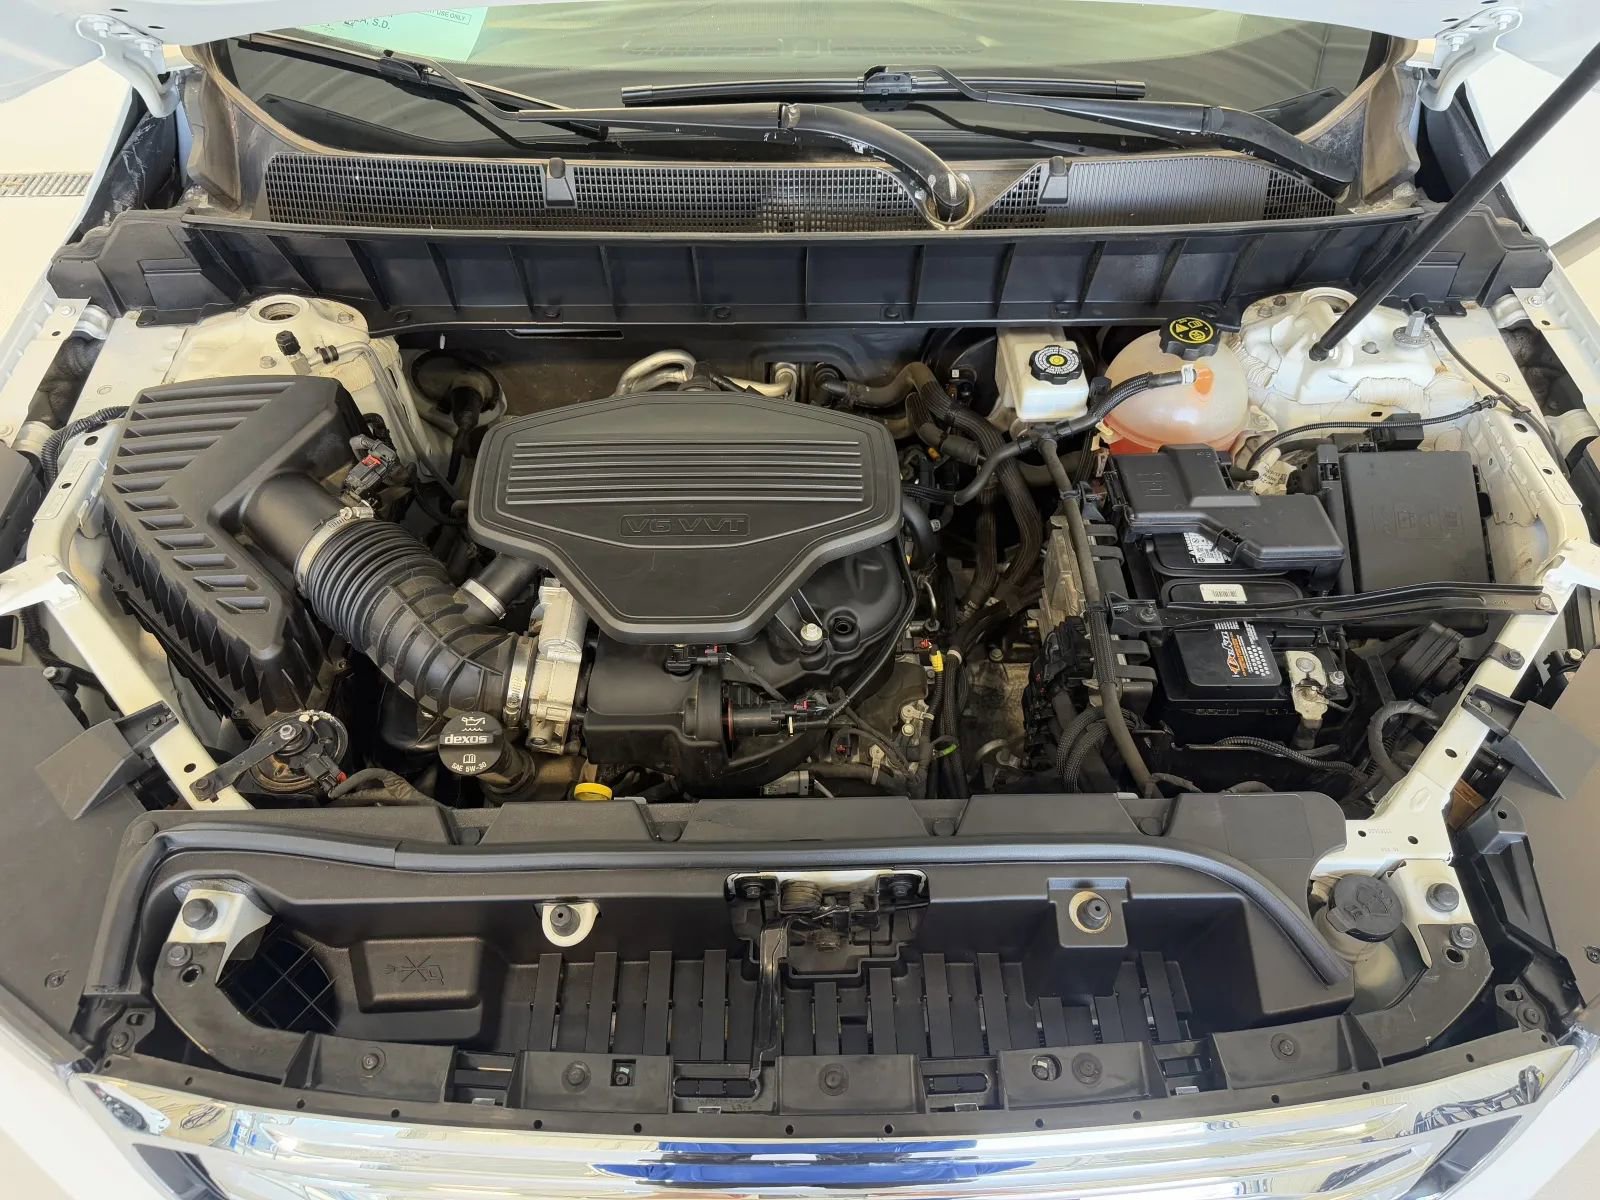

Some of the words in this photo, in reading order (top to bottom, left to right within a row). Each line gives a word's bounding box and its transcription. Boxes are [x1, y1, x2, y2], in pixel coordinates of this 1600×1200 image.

[371, 18, 390, 30] S.D.
[626, 518, 672, 533] V6
[677, 518, 745, 532] VVT
[444, 733, 490, 744] dexos
[451, 762, 464, 772] SAE
[465, 761, 487, 773] 5W-30
